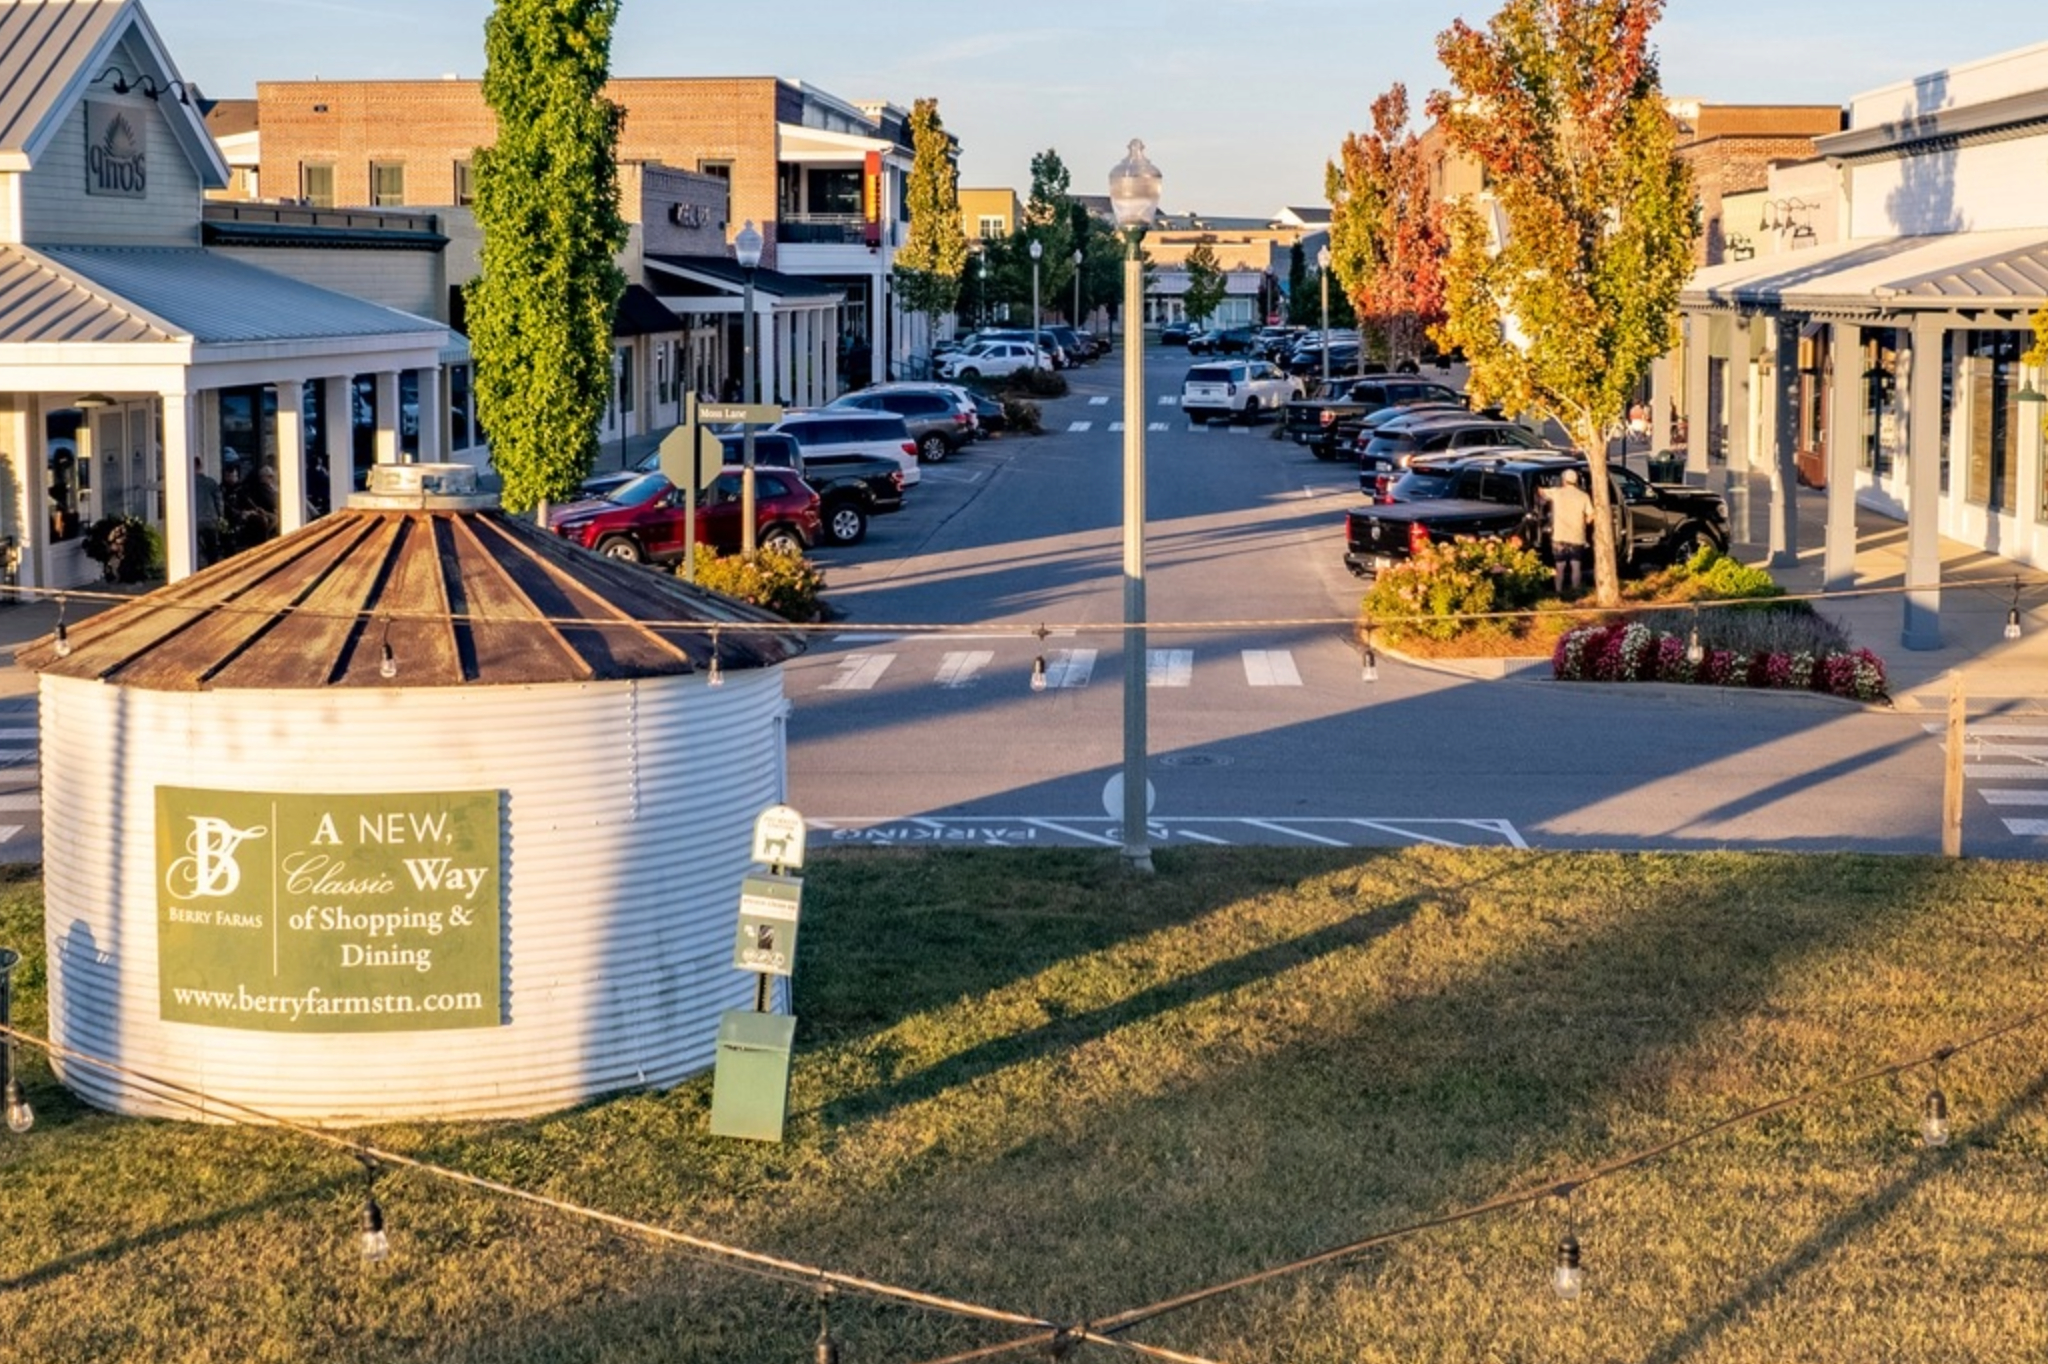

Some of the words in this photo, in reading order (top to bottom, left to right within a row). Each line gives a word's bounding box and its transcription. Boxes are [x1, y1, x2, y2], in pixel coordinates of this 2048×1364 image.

[725, 408, 747, 420] Lane
[310, 812, 343, 845] A
[359, 812, 453, 845] NEW,
[832, 827, 1036, 840] PARKING
[282, 851, 395, 894] Classic
[402, 857, 489, 900] Way
[169, 907, 213, 925] BERRY
[216, 911, 264, 929] FARMS
[289, 906, 319, 930] of
[319, 905, 444, 937] Shopping
[449, 904, 474, 926] &
[340, 943, 433, 973] Dining
[173, 983, 483, 1022] www.berryfarmstn.com
